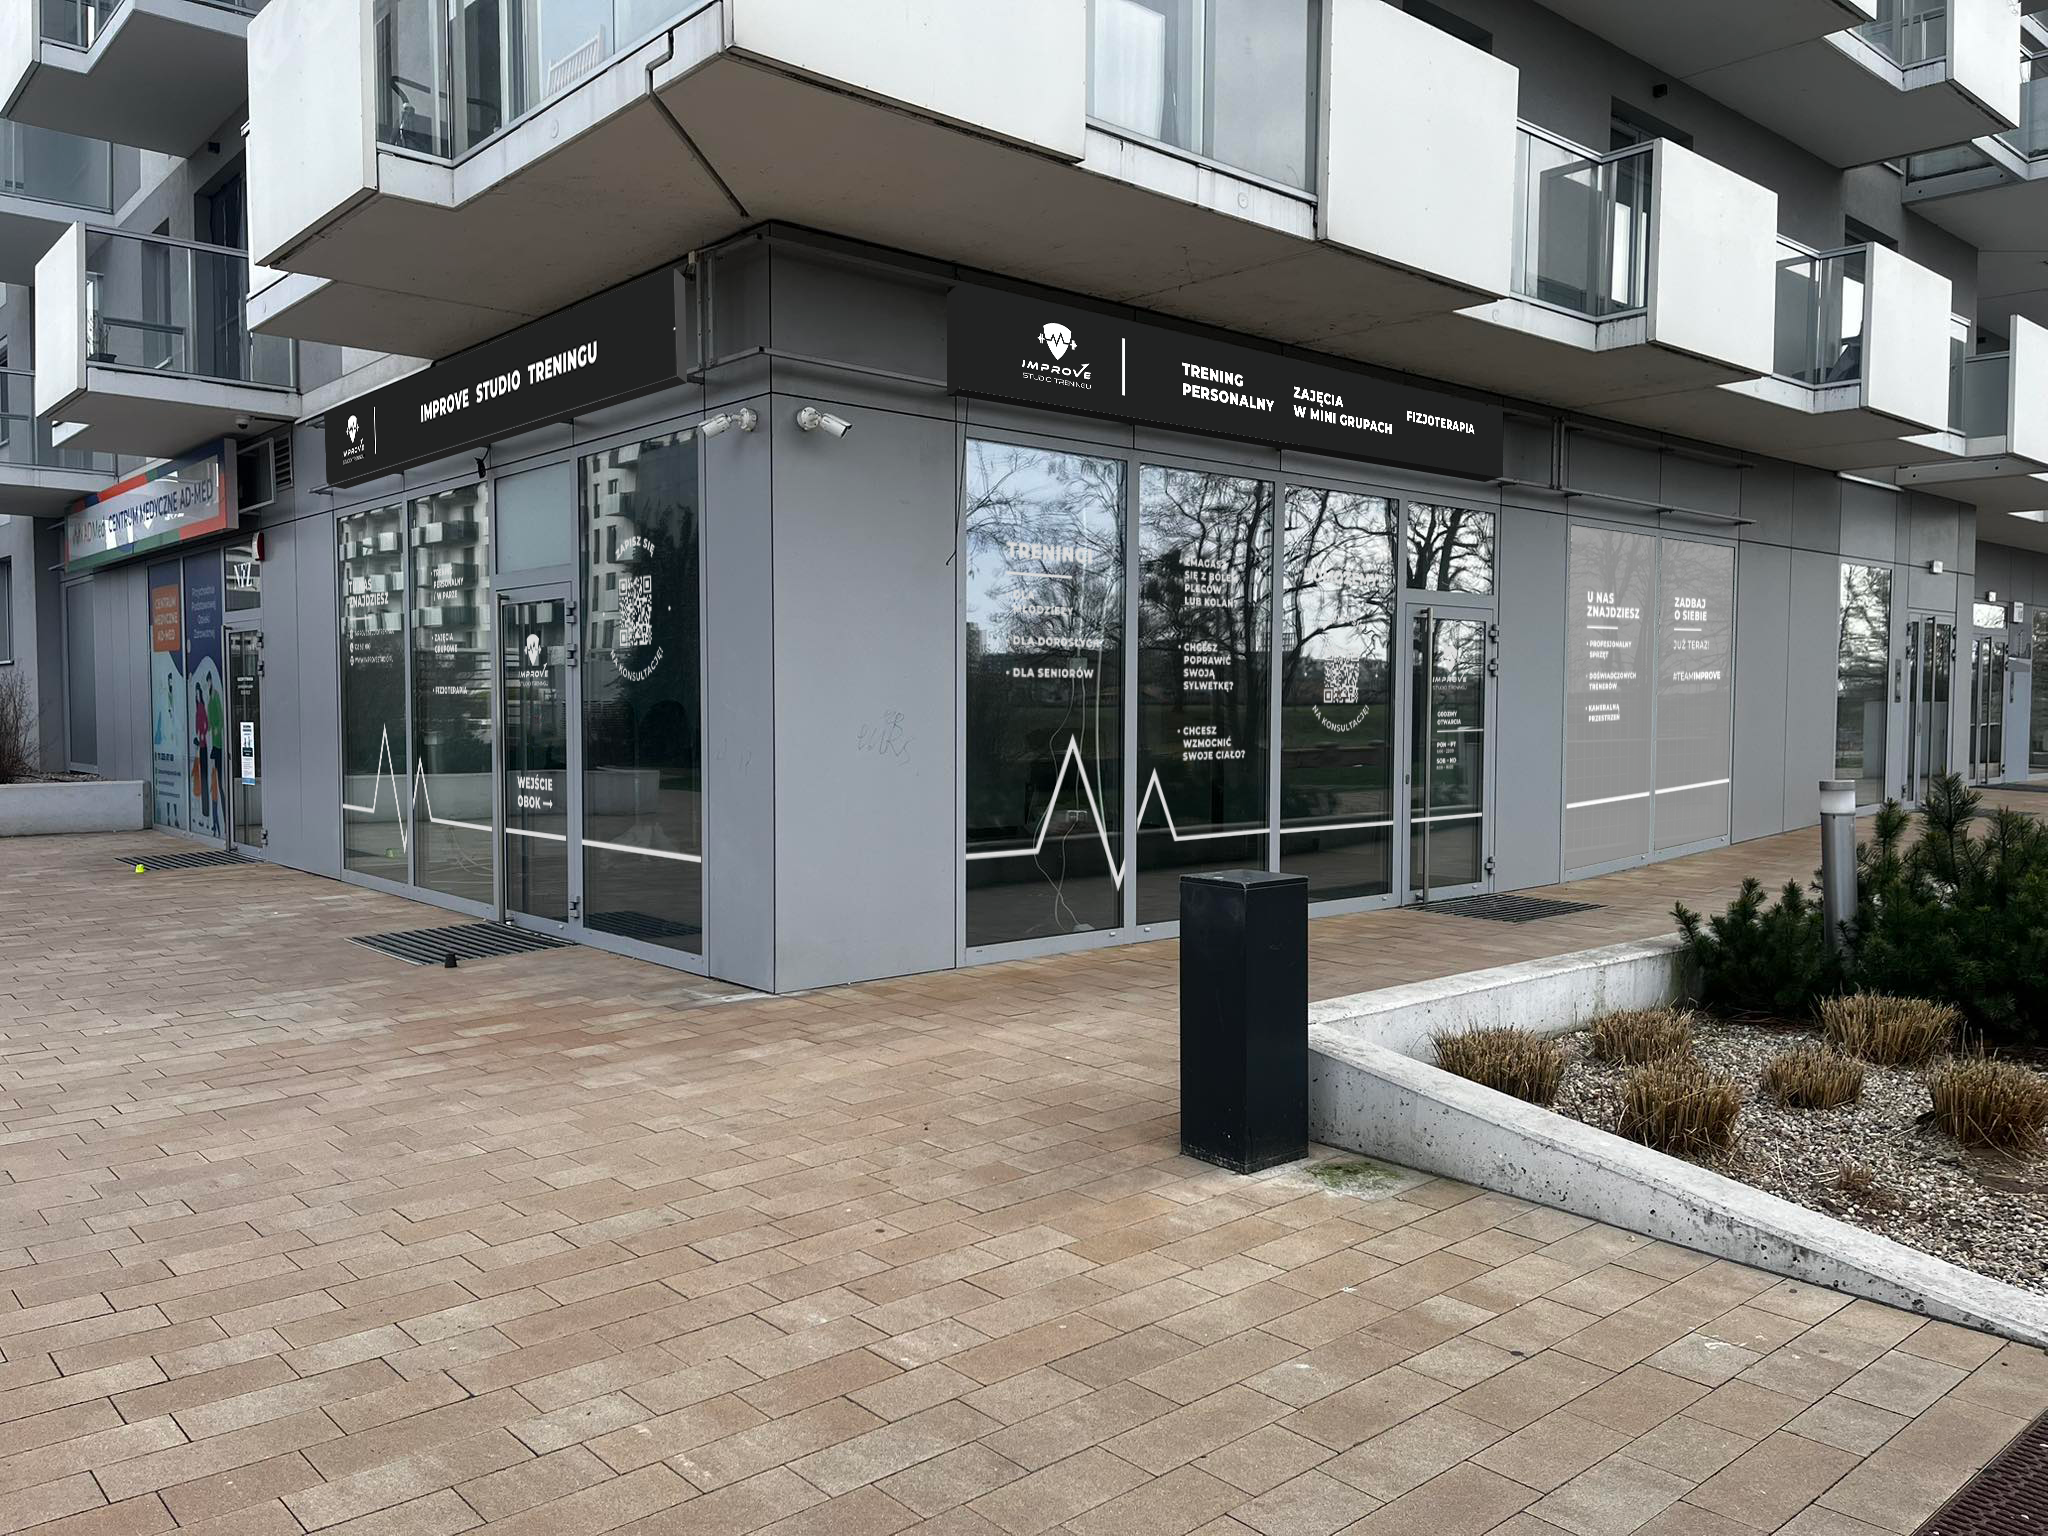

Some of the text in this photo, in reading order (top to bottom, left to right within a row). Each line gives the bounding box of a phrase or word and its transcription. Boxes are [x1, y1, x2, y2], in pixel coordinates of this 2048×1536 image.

[1022, 360, 1092, 380] IMPROVE
[1182, 362, 1244, 387] TRENING
[420, 340, 598, 423] IMPROVE STUDIO TRENINGU
[1022, 372, 1092, 390] STUDO TRENNGU
[1182, 382, 1274, 412] PERSONALNY
[1293, 386, 1343, 408] ZAJĘCIA
[1294, 405, 1393, 434] W MINI GRUPACH
[1406, 410, 1475, 434] FIZJOTERAPIA
[108, 510, 138, 532] CENTRUM
[140, 491, 178, 522] MEDYCZNE
[615, 536, 655, 560] ZAPISZ SIĘ
[1006, 541, 1093, 564] TRENINGI
[1184, 570, 1198, 583] SIĘ
[1201, 572, 1207, 580] Z
[434, 577, 463, 589] PERSONALNY
[1184, 583, 1222, 594] PLECÓW
[349, 592, 389, 608] ZNAJDZIESZ
[443, 590, 457, 600] PARZE
[1013, 590, 1034, 600] DLA
[1588, 591, 1614, 604] U NAS
[1184, 596, 1238, 608] LUB KOLAN?
[1674, 597, 1706, 609] ZADBAJ
[1587, 605, 1640, 619] ZNAJDZIESZ
[1674, 610, 1707, 621] O SIEBIE
[434, 633, 454, 643] ZAJĘCIA
[1013, 636, 1100, 648] DLA DOROSŁYCH
[1590, 640, 1632, 648] PROFESJONALNY
[1673, 638, 1710, 650] JUŻ TERAZ!
[434, 644, 458, 654] GRUPOWE
[1184, 642, 1218, 652] CHCESZ
[1184, 654, 1231, 666] POPRAWIĆ
[1590, 650, 1609, 660] SPRZĘT
[618, 646, 664, 682] KONSULTACJĘ!
[518, 663, 548, 678] IMPROVE
[1013, 666, 1094, 678] DLA SENIORÓW
[1183, 668, 1215, 680] SWOJĄ
[1432, 671, 1467, 682] IMPROVE
[1589, 670, 1637, 680] DOŚWIADCZONYCH
[1673, 671, 1721, 681] #TEAMIMPROVE
[435, 686, 468, 695] FIZJOTERAPIA
[1183, 681, 1234, 693] SYLWETKĘ?
[1589, 681, 1617, 691] TRENERÓW
[1312, 704, 1370, 732] NA KONSULTACJĘ!
[1183, 726, 1217, 736] CHCESZ
[1183, 735, 1232, 748] WZMOCNIĆ
[1182, 749, 1246, 761] SWOJE CIAŁO?
[517, 774, 553, 791] WEJŚCIE
[517, 795, 541, 809] OBOK
